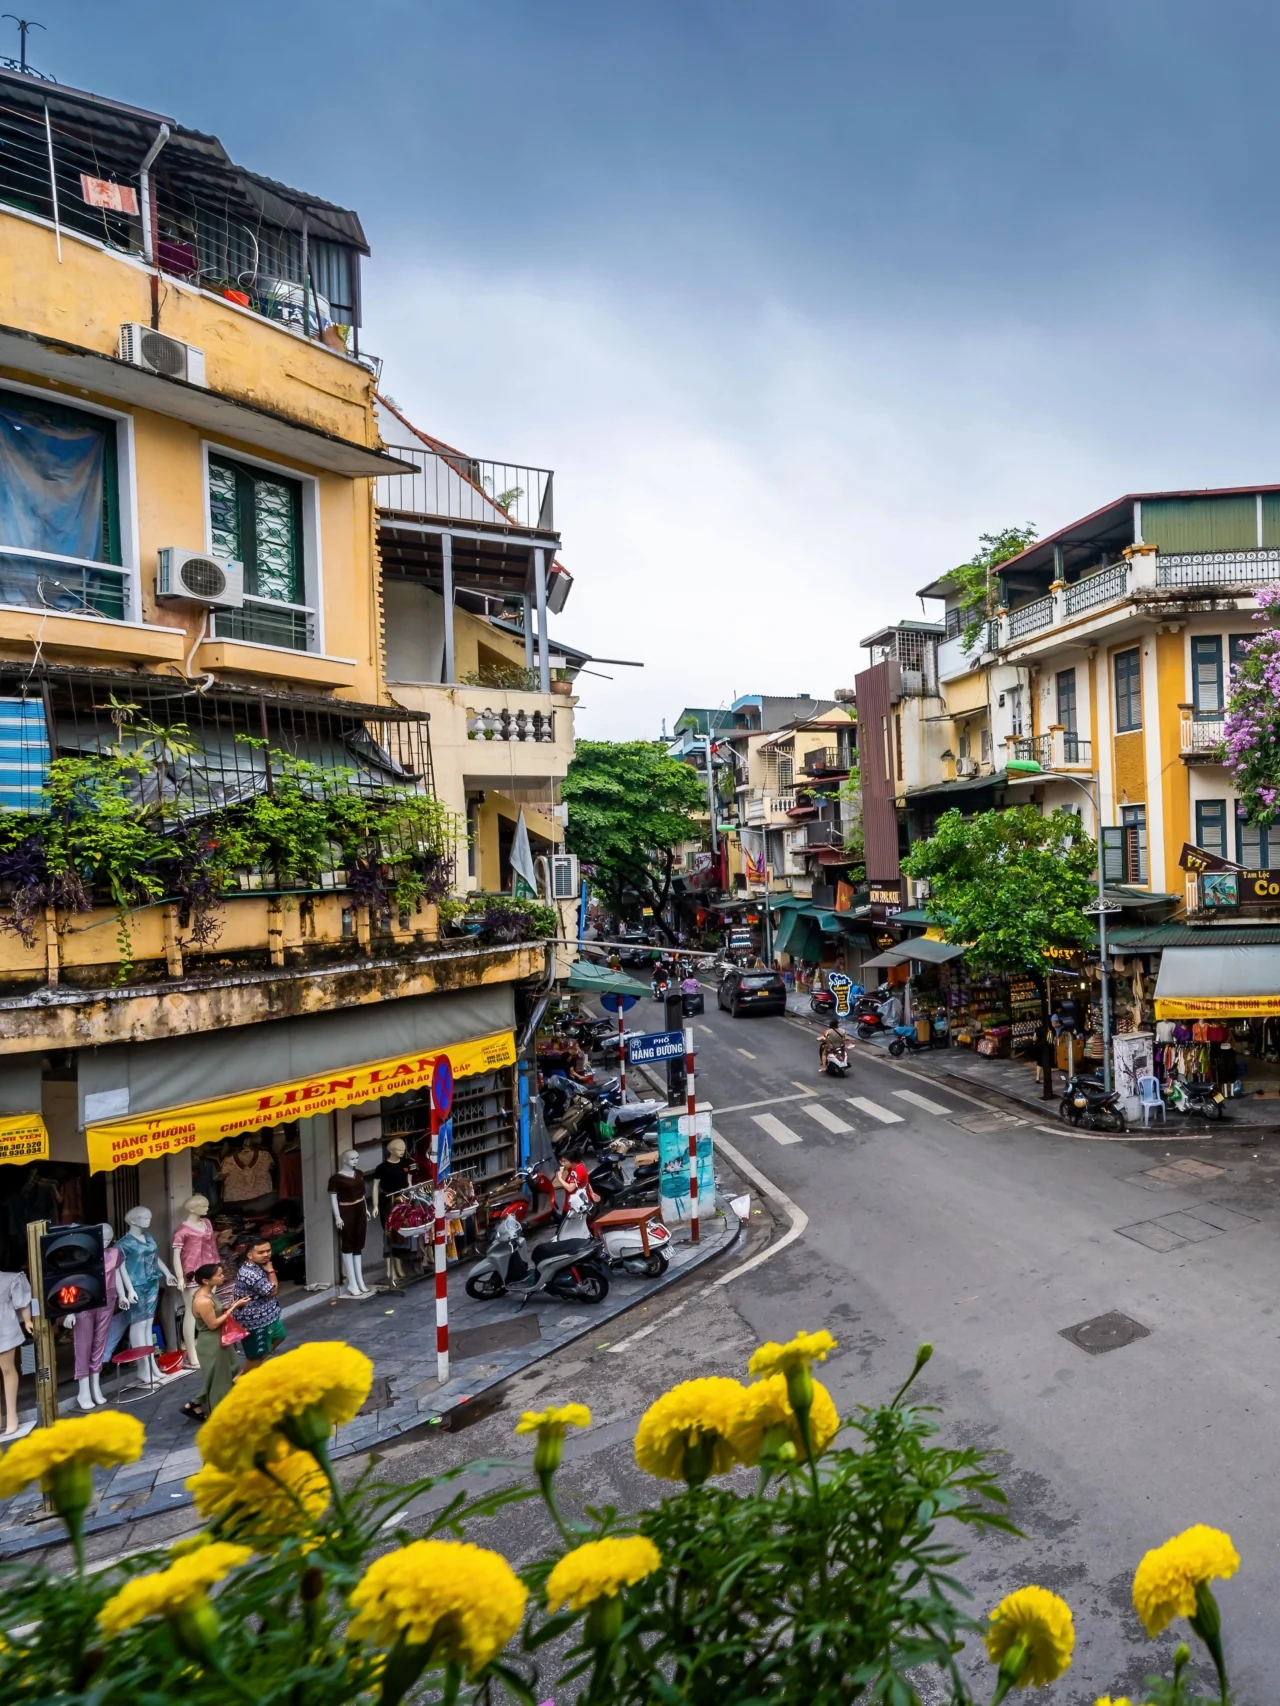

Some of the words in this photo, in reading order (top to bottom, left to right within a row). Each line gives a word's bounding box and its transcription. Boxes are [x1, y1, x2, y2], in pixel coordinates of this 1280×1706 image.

[1243, 871, 1258, 879] Tam
[833, 976, 847, 988] Spa
[1184, 999, 1217, 1011] CHUYÊN
[653, 1035, 670, 1045] PHỐ
[631, 1047, 655, 1060] HÀNG
[656, 1043, 683, 1057] ĐƯỜNG
[257, 1076, 357, 1111] LIÊN
[220, 1113, 272, 1132] CHUYÊN
[275, 1105, 301, 1119] BÁN
[304, 1097, 336, 1112] BUÔN
[347, 1088, 369, 1101] BÁN
[146, 1120, 161, 1130] 77
[112, 1135, 148, 1151] HÀNG
[152, 1123, 196, 1141] ĐƯỜNG
[112, 1148, 144, 1164] 0989
[148, 1141, 170, 1154] 158
[173, 1134, 196, 1147] 338
